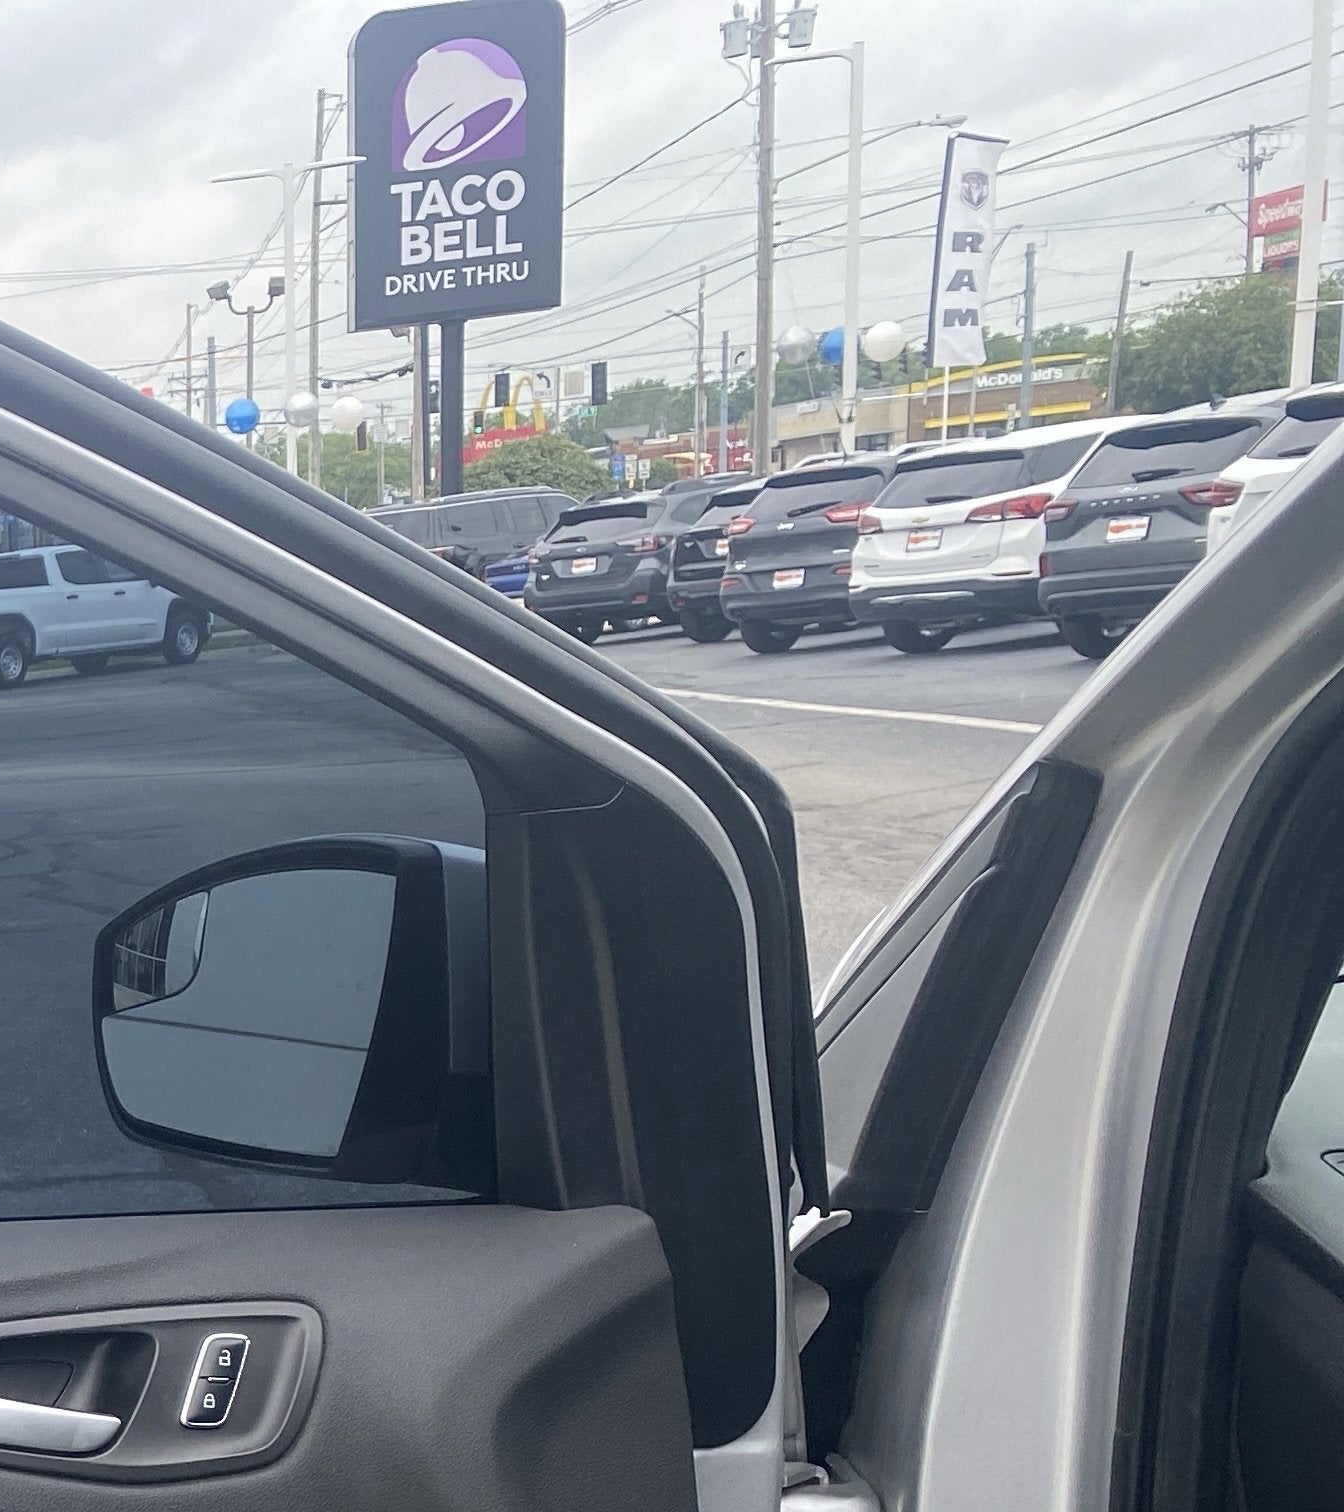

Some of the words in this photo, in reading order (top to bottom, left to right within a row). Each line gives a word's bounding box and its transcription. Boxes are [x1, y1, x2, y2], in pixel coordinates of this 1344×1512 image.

[390, 169, 526, 222] TACO
[400, 214, 523, 266] BELL
[385, 268, 456, 296] DRIVE
[462, 260, 530, 285] THRU
[943, 231, 984, 327] RAM
